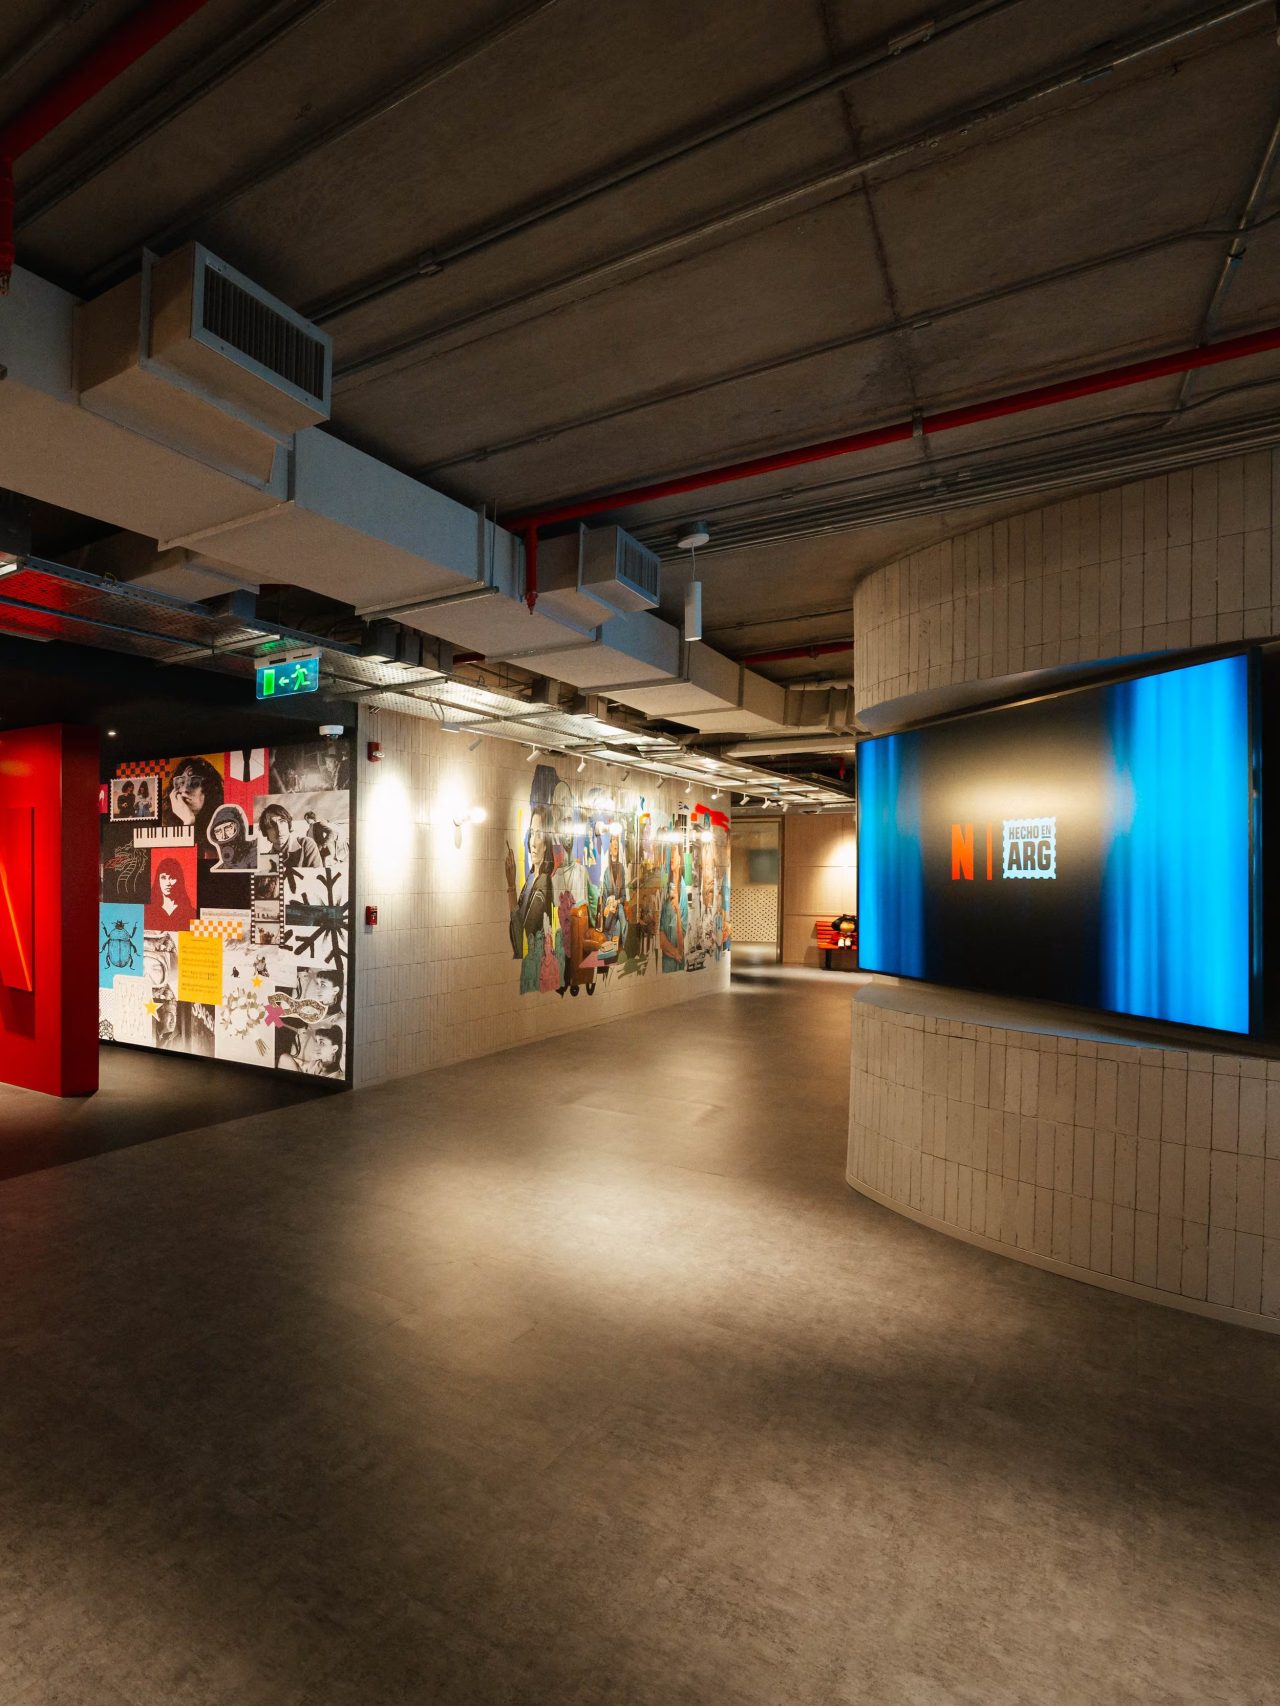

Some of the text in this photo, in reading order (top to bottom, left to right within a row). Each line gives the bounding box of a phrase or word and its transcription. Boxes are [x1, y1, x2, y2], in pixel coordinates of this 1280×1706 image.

[1009, 825, 1051, 840] HECHO EN
[951, 823, 974, 880] N
[1007, 840, 1051, 871] ARG
